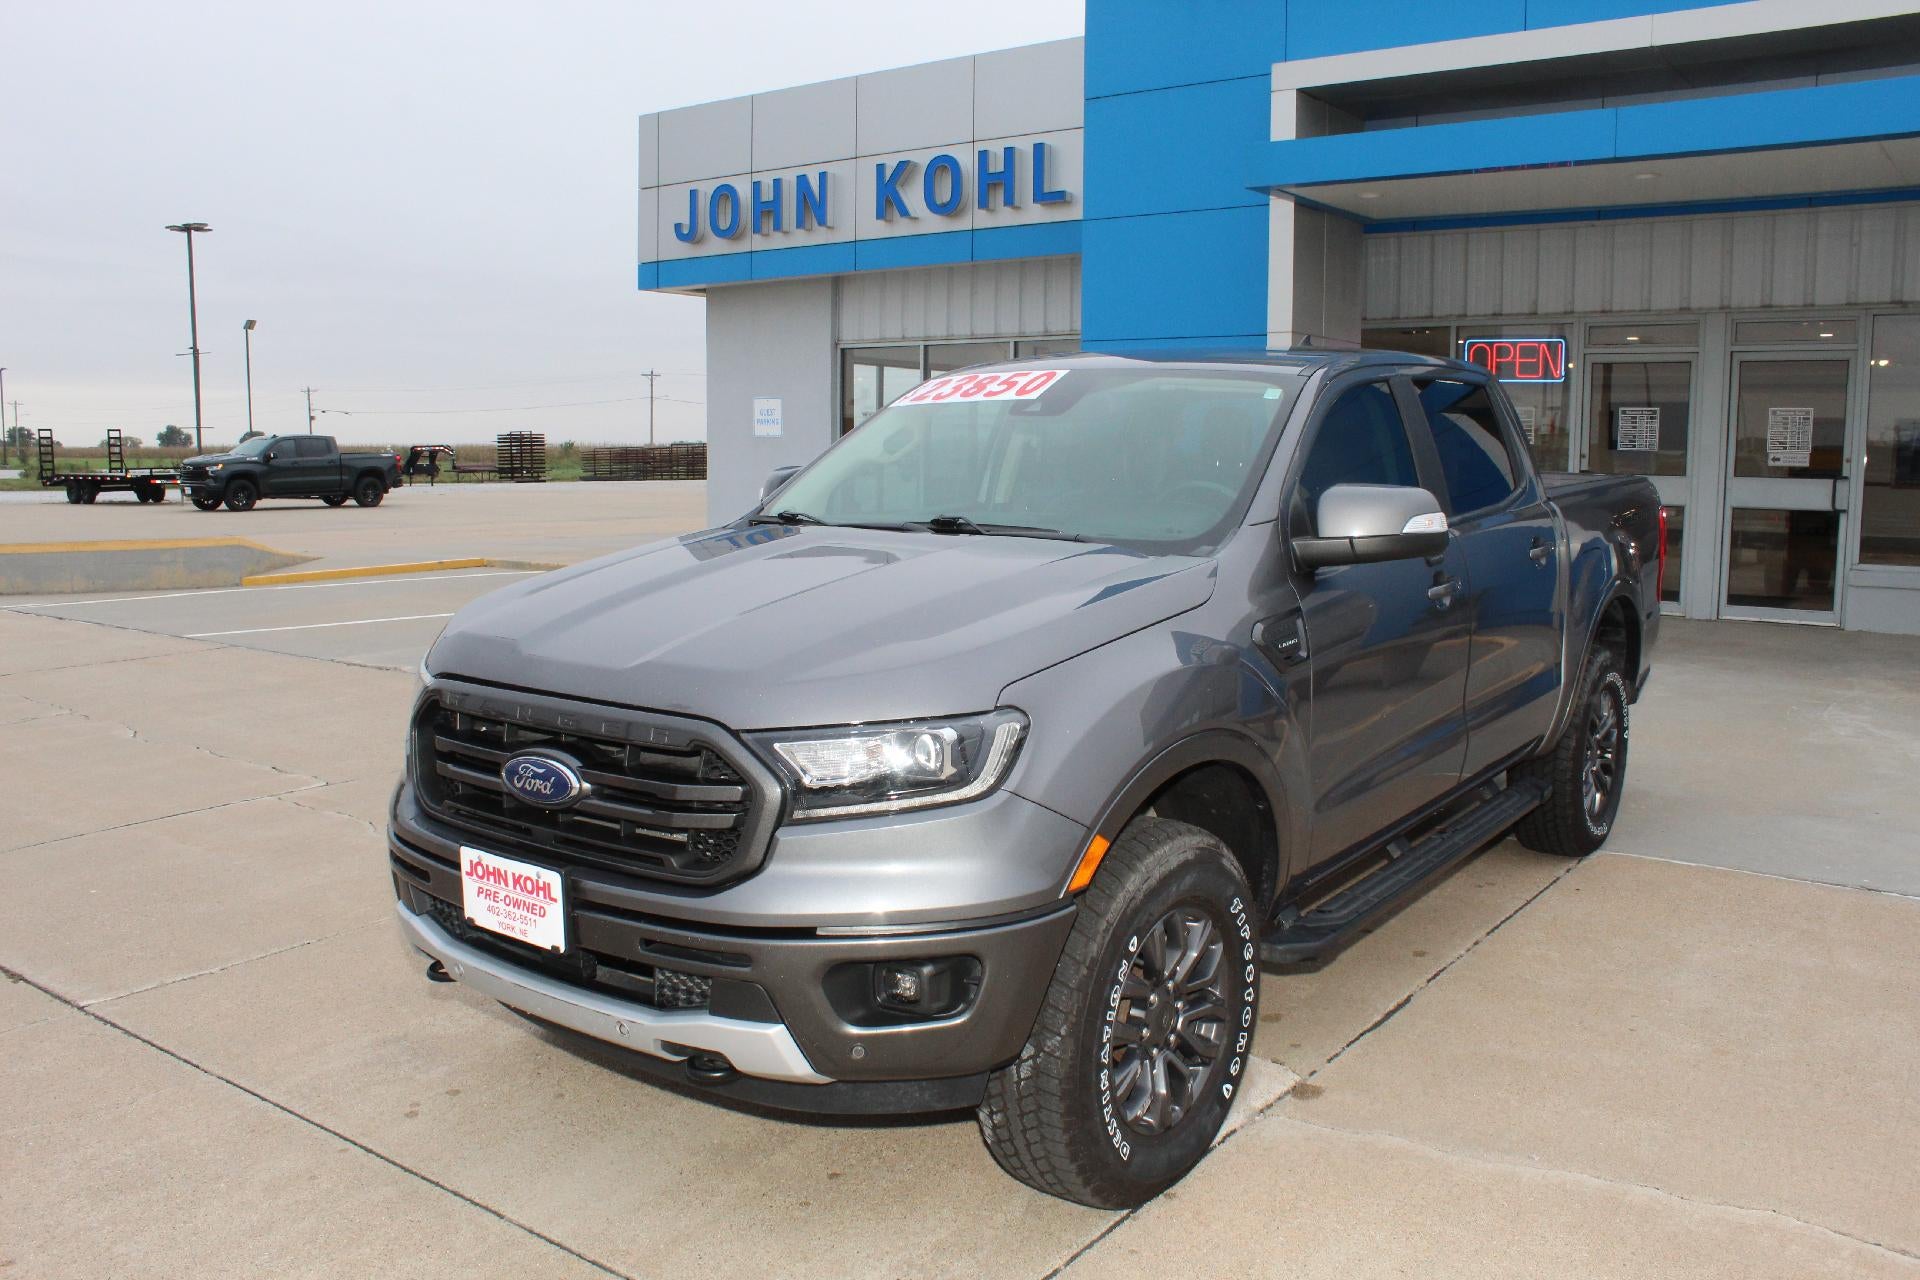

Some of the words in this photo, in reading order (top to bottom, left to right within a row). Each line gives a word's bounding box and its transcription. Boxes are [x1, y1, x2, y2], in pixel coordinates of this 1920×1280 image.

[674, 170, 834, 244] JOHN
[875, 142, 1072, 221] KOHL
[1469, 343, 1562, 378] OPEN
[514, 763, 556, 795] Ford
[465, 859, 509, 888] JOHN
[511, 871, 558, 903] KOHL
[477, 886, 547, 918] PRE-OWNED
[486, 903, 538, 929] 402-362-5511
[519, 928, 529, 937] NE
[1099, 959, 1131, 1161] DESTINATION
